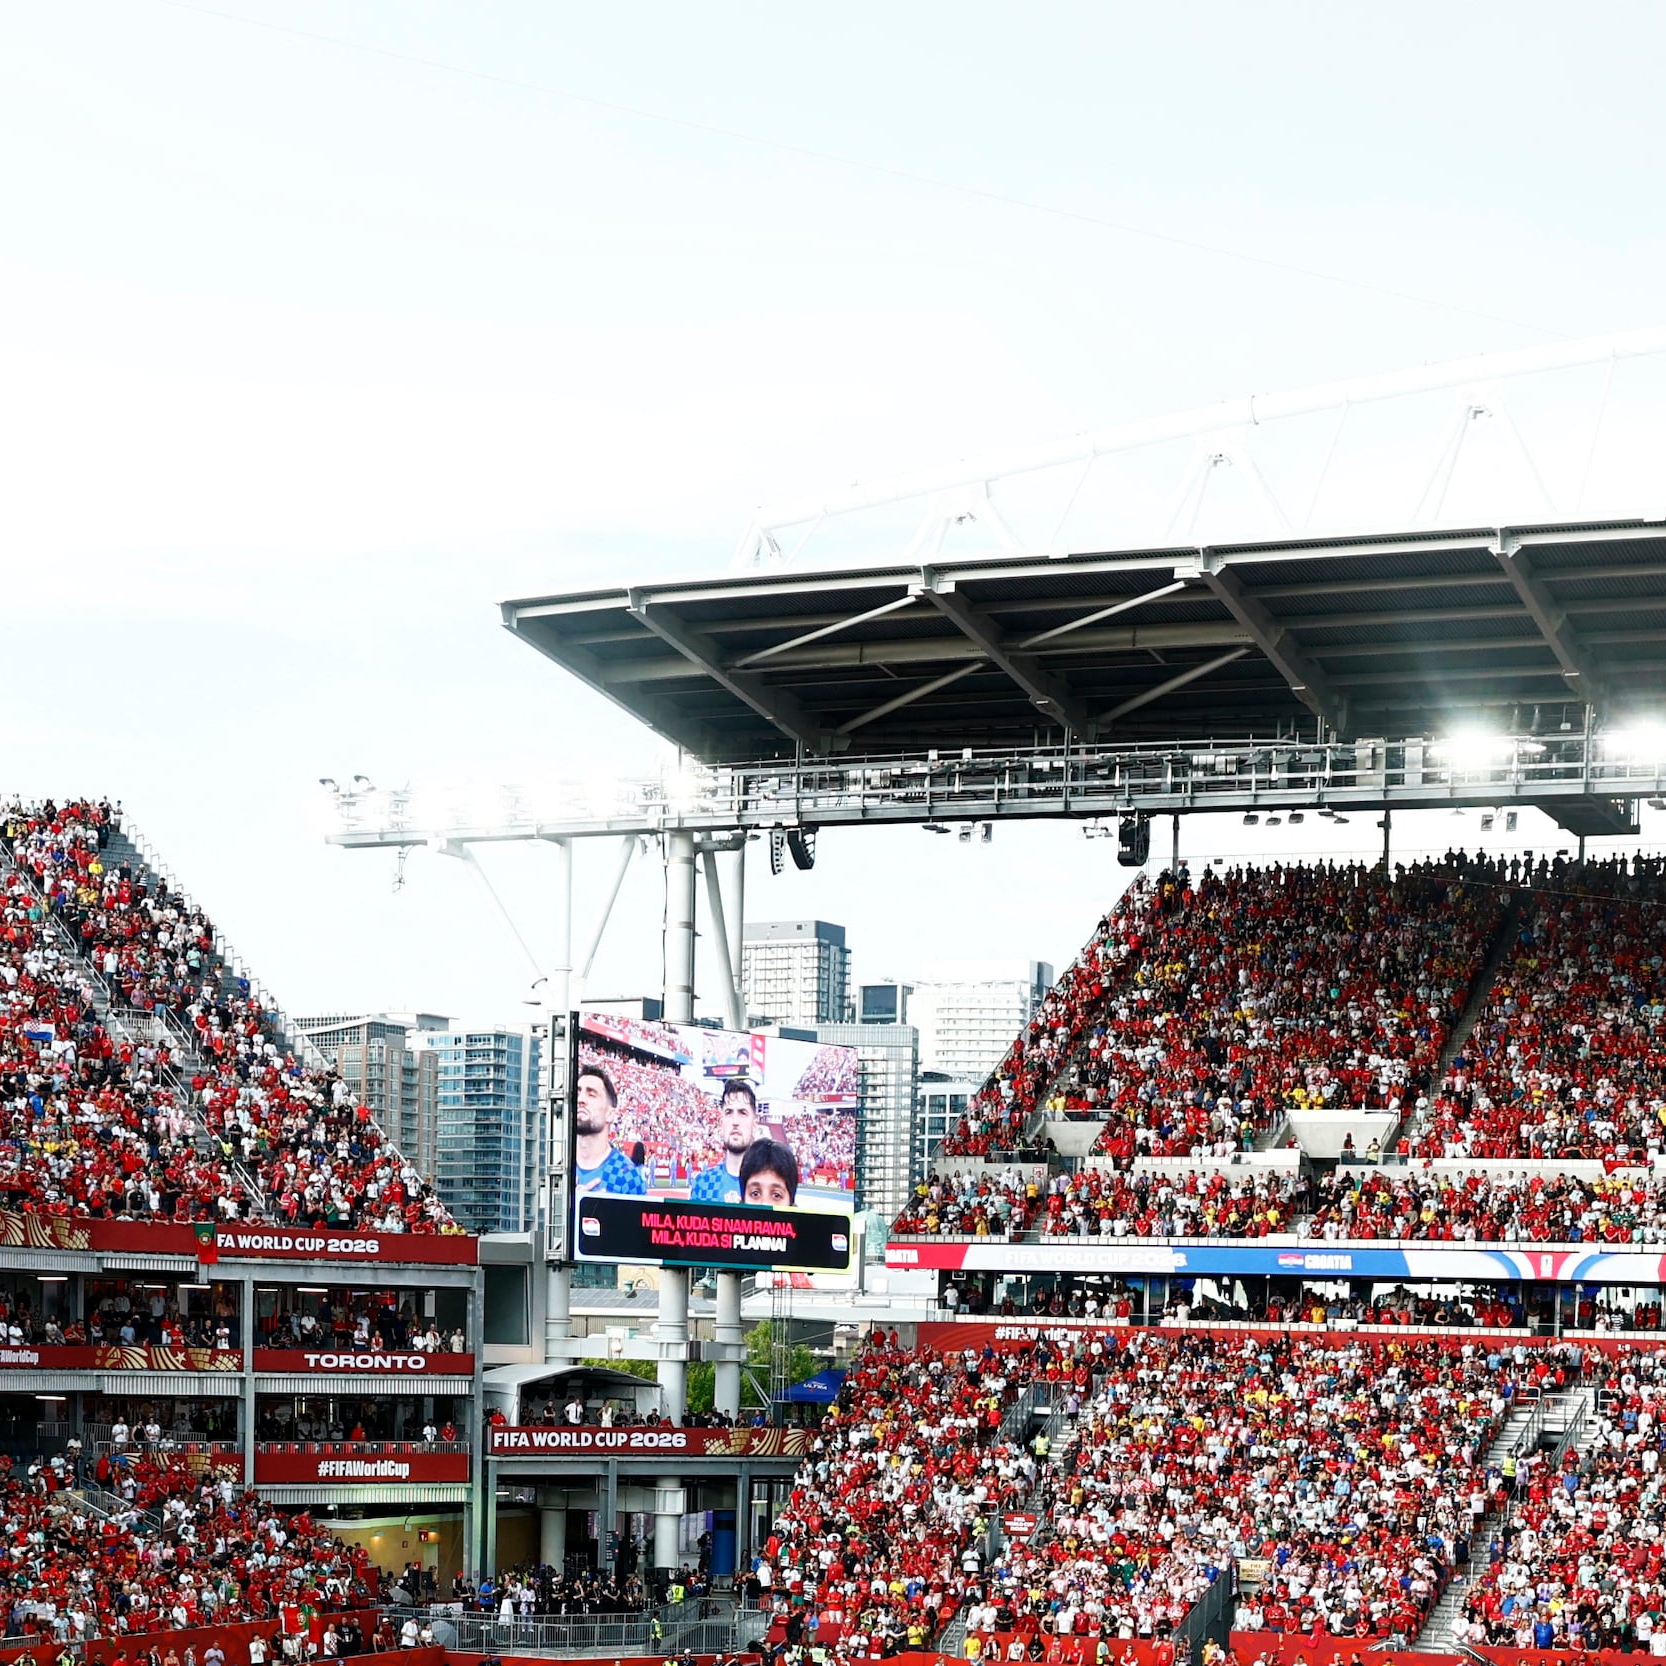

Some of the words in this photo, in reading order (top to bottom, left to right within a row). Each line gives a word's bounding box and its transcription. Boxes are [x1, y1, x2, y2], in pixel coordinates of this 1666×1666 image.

[641, 1212, 675, 1230] MILA,
[676, 1215, 710, 1231] KUDA
[711, 1217, 723, 1232] SI
[724, 1218, 752, 1234] NAM
[754, 1220, 796, 1239] RAVNA,
[217, 1234, 235, 1248] FA
[237, 1235, 293, 1250] WORLD
[295, 1237, 325, 1251] CUP
[327, 1239, 379, 1253] 2026
[651, 1229, 684, 1247] MILA,
[686, 1231, 719, 1247] KUDA
[721, 1234, 732, 1248] SI
[1132, 1253, 1187, 1267] 2026
[1305, 1255, 1353, 1271] CROATIA
[303, 1353, 426, 1370] TORONTO
[493, 1432, 530, 1448] FIFA
[532, 1432, 595, 1448] WORLD
[597, 1432, 627, 1448] CUP
[629, 1433, 688, 1449] 2026
[317, 1459, 410, 1480] #FIFAWorldCup
